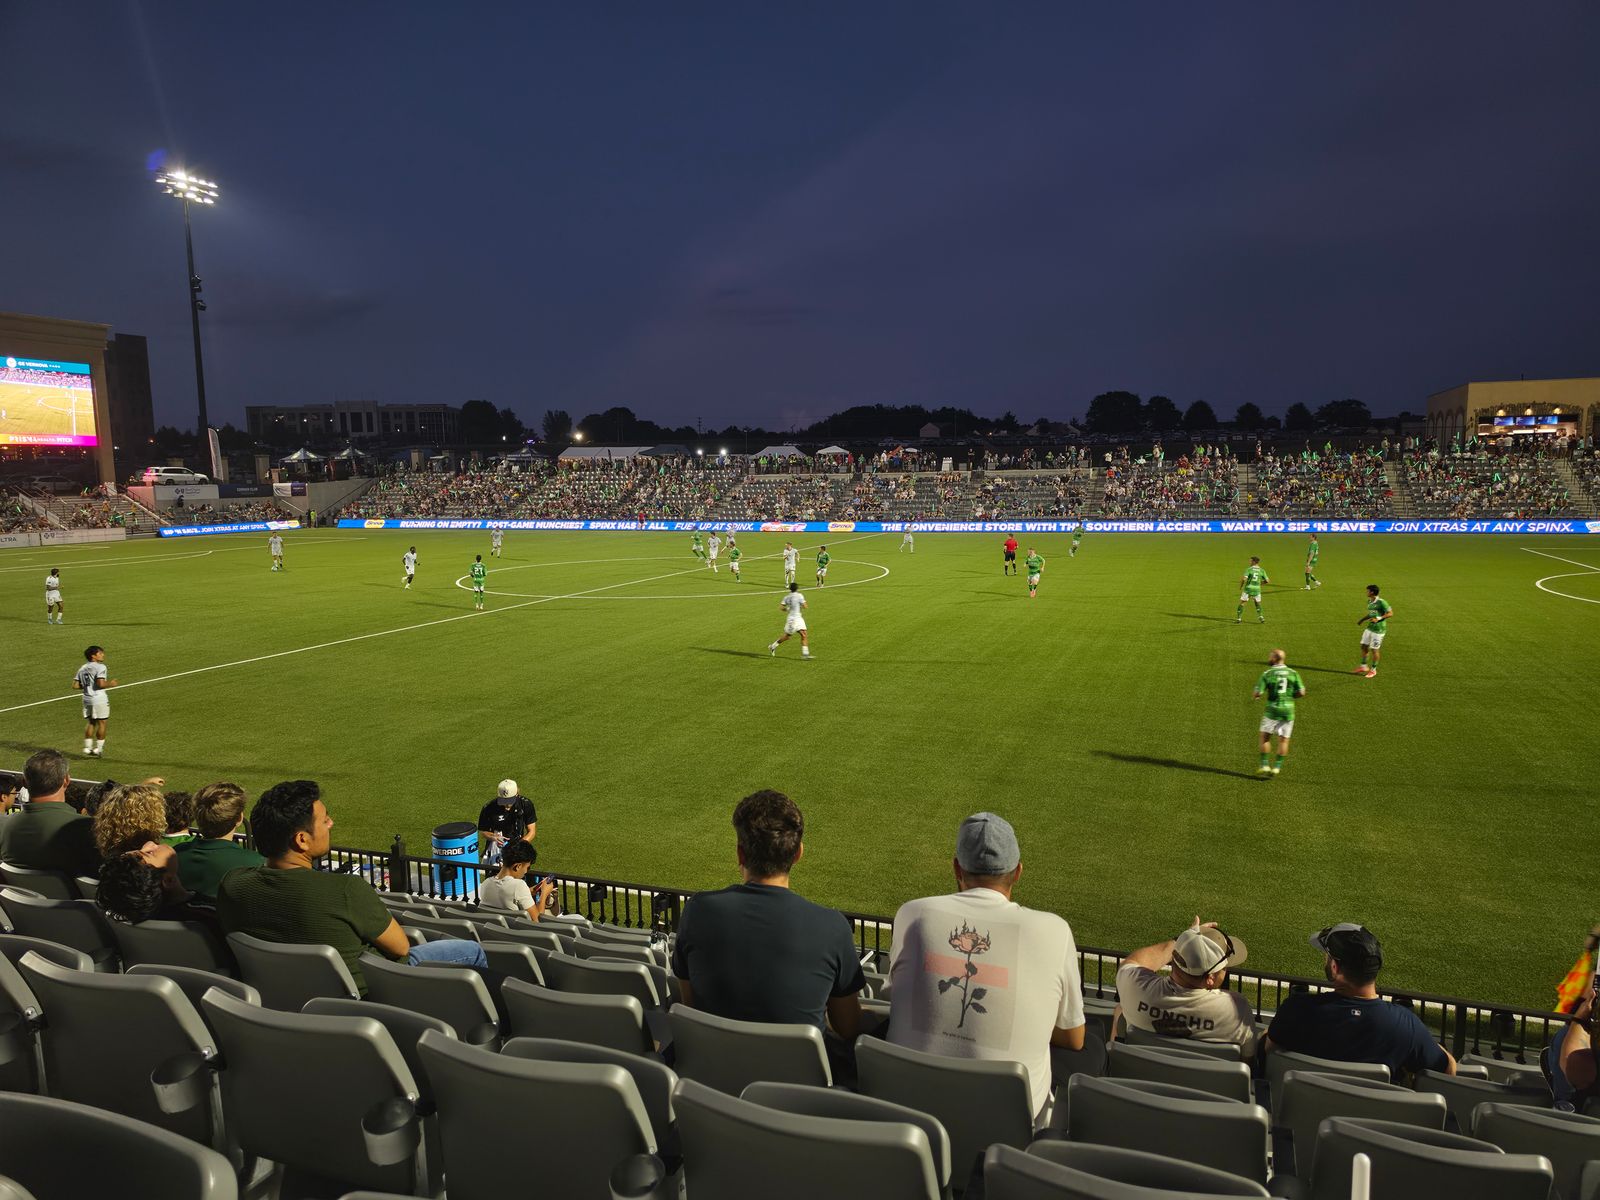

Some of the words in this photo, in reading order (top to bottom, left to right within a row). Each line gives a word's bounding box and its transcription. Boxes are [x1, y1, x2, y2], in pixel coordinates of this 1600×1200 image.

[881, 523, 902, 531] THE
[904, 523, 982, 531] CONVENIENCE
[984, 523, 1023, 531] STORE
[1025, 523, 1056, 531] WITH
[1086, 522, 1154, 531] SOUTHERN
[1157, 522, 1211, 531] ACCENT.
[1221, 522, 1263, 531] WANT
[1266, 522, 1285, 531] TO
[1288, 522, 1310, 531] SIP
[1331, 522, 1376, 531] SAVE?
[1386, 522, 1419, 531] JOIN
[1422, 522, 1468, 532] XTRAS
[1471, 522, 1490, 532] AT
[1492, 522, 1525, 532] ANY
[1526, 522, 1574, 532] SPINX.
[1277, 677, 1287, 694] 3
[1137, 1002, 1214, 1030] PONCHO
